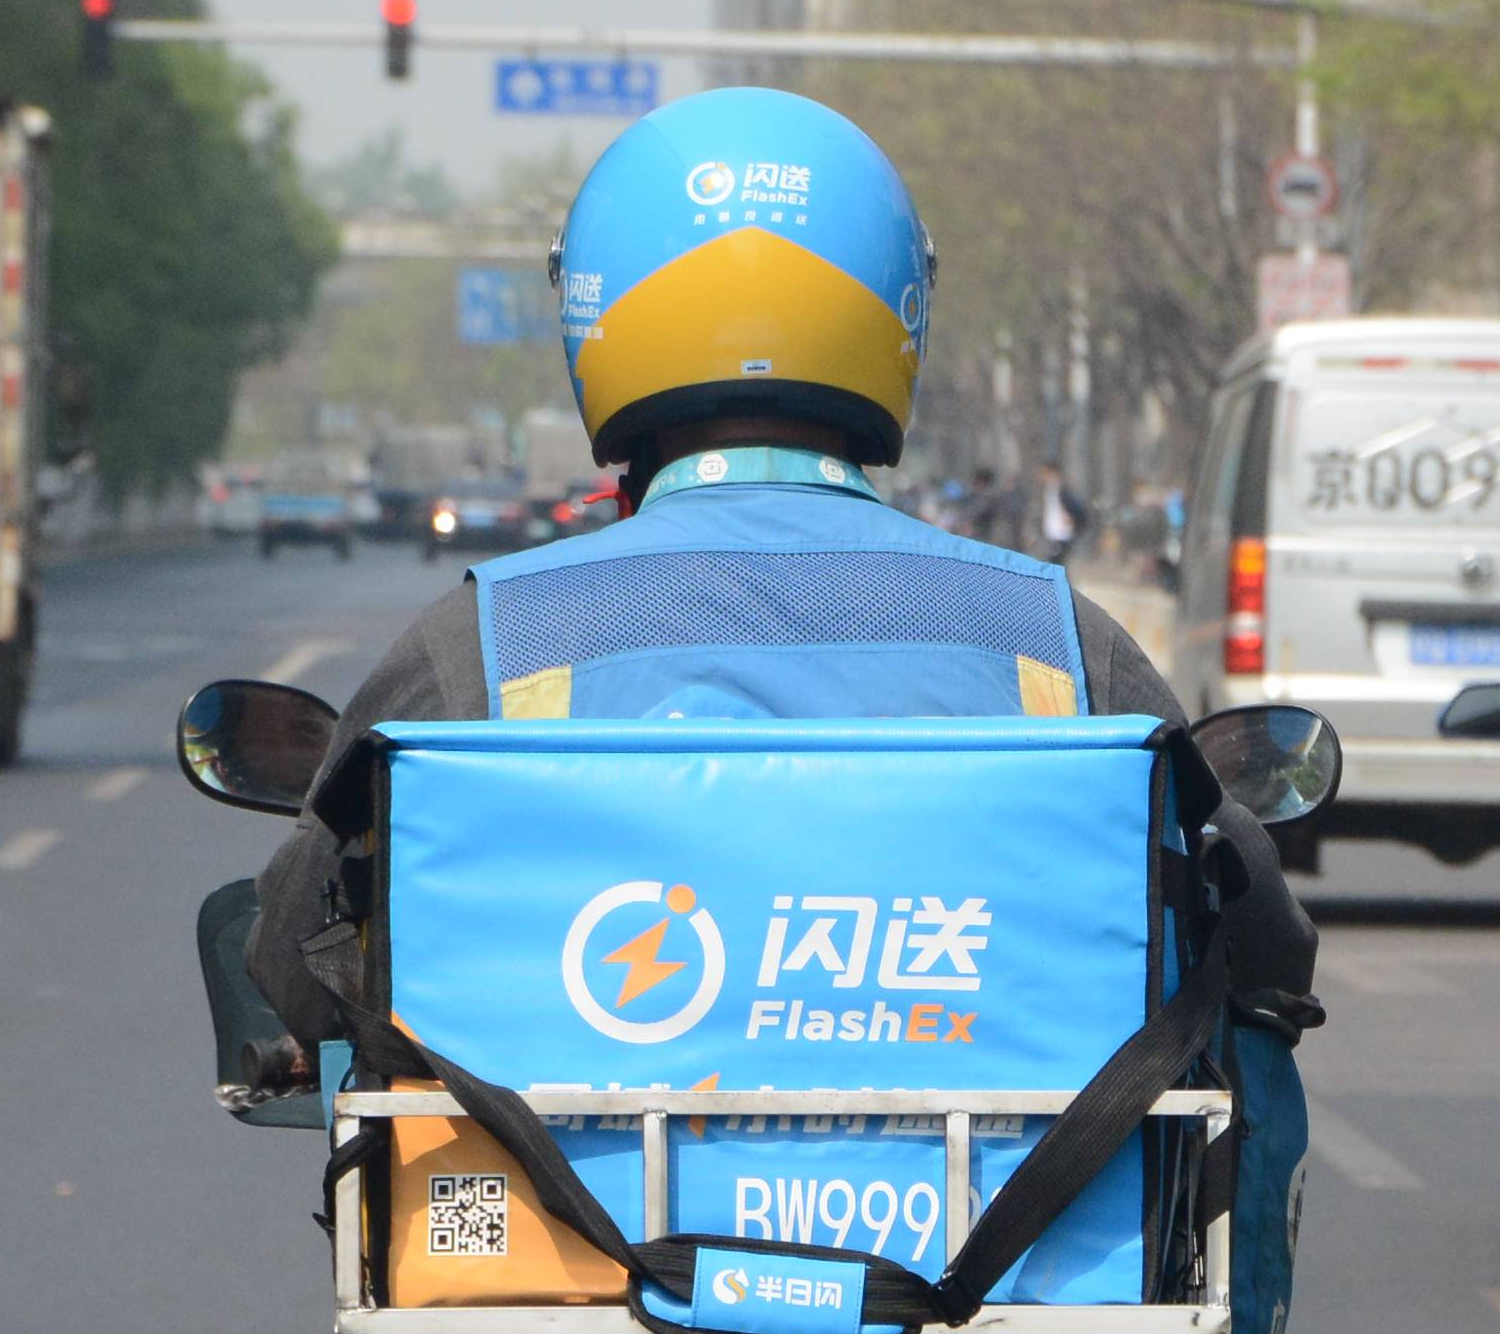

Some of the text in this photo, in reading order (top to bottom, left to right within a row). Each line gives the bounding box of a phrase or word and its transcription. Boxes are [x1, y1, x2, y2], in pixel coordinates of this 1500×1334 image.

[743, 162, 811, 192] 闪送
[740, 188, 808, 206] FlashEx
[569, 272, 602, 303] 闪送
[756, 896, 992, 991] 闪送
[746, 1000, 978, 1043] FlashEx
[755, 1273, 844, 1310] 半日闪
